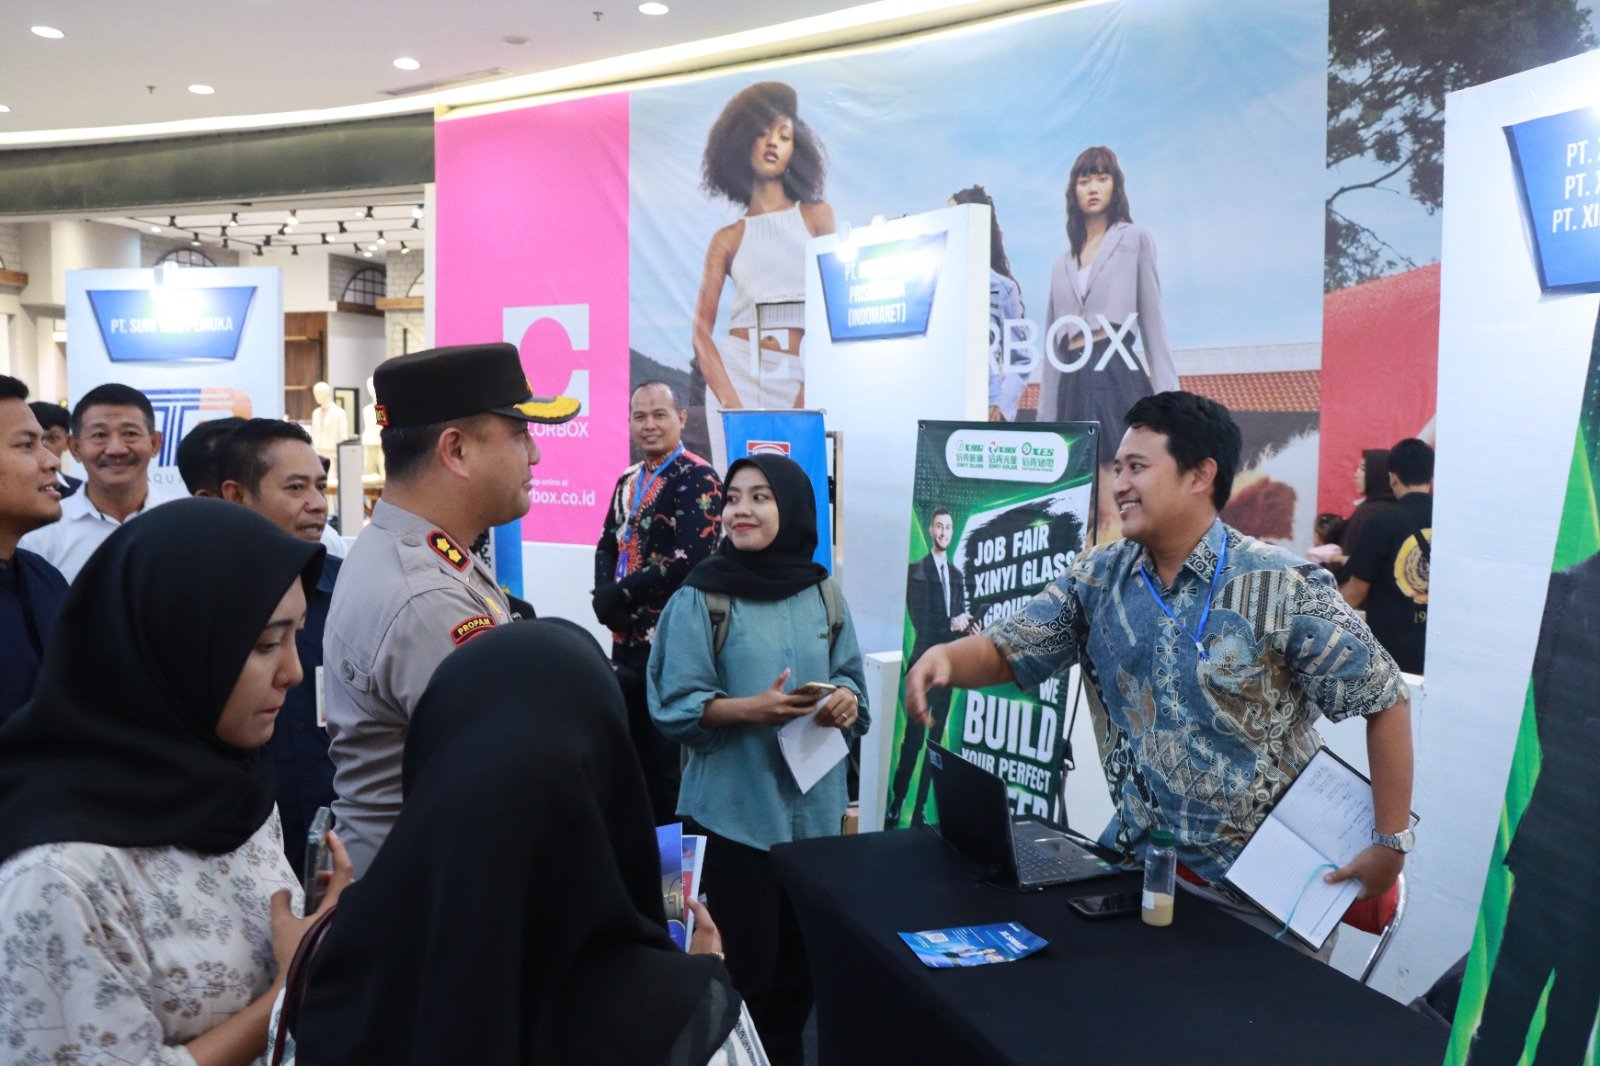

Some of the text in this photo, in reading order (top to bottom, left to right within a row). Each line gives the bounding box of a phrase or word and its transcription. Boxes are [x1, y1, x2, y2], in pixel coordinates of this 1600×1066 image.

[1566, 139, 1593, 168] PT.
[1564, 172, 1591, 200] PT.
[1552, 202, 1600, 233] PT. XI
[844, 261, 858, 282] PT.
[110, 318, 128, 334] PT.
[848, 301, 907, 328] (INDOMARET)
[527, 420, 589, 437] LORBOX
[528, 489, 595, 506] rbox.co.id
[973, 524, 1050, 567] JOB FAIR
[974, 550, 1076, 598] XINYI GLASS
[457, 618, 491, 636] PROPAM
[1039, 677, 1060, 704] WE
[963, 689, 1057, 764] BUILD
[998, 757, 1051, 794] PERFECT
